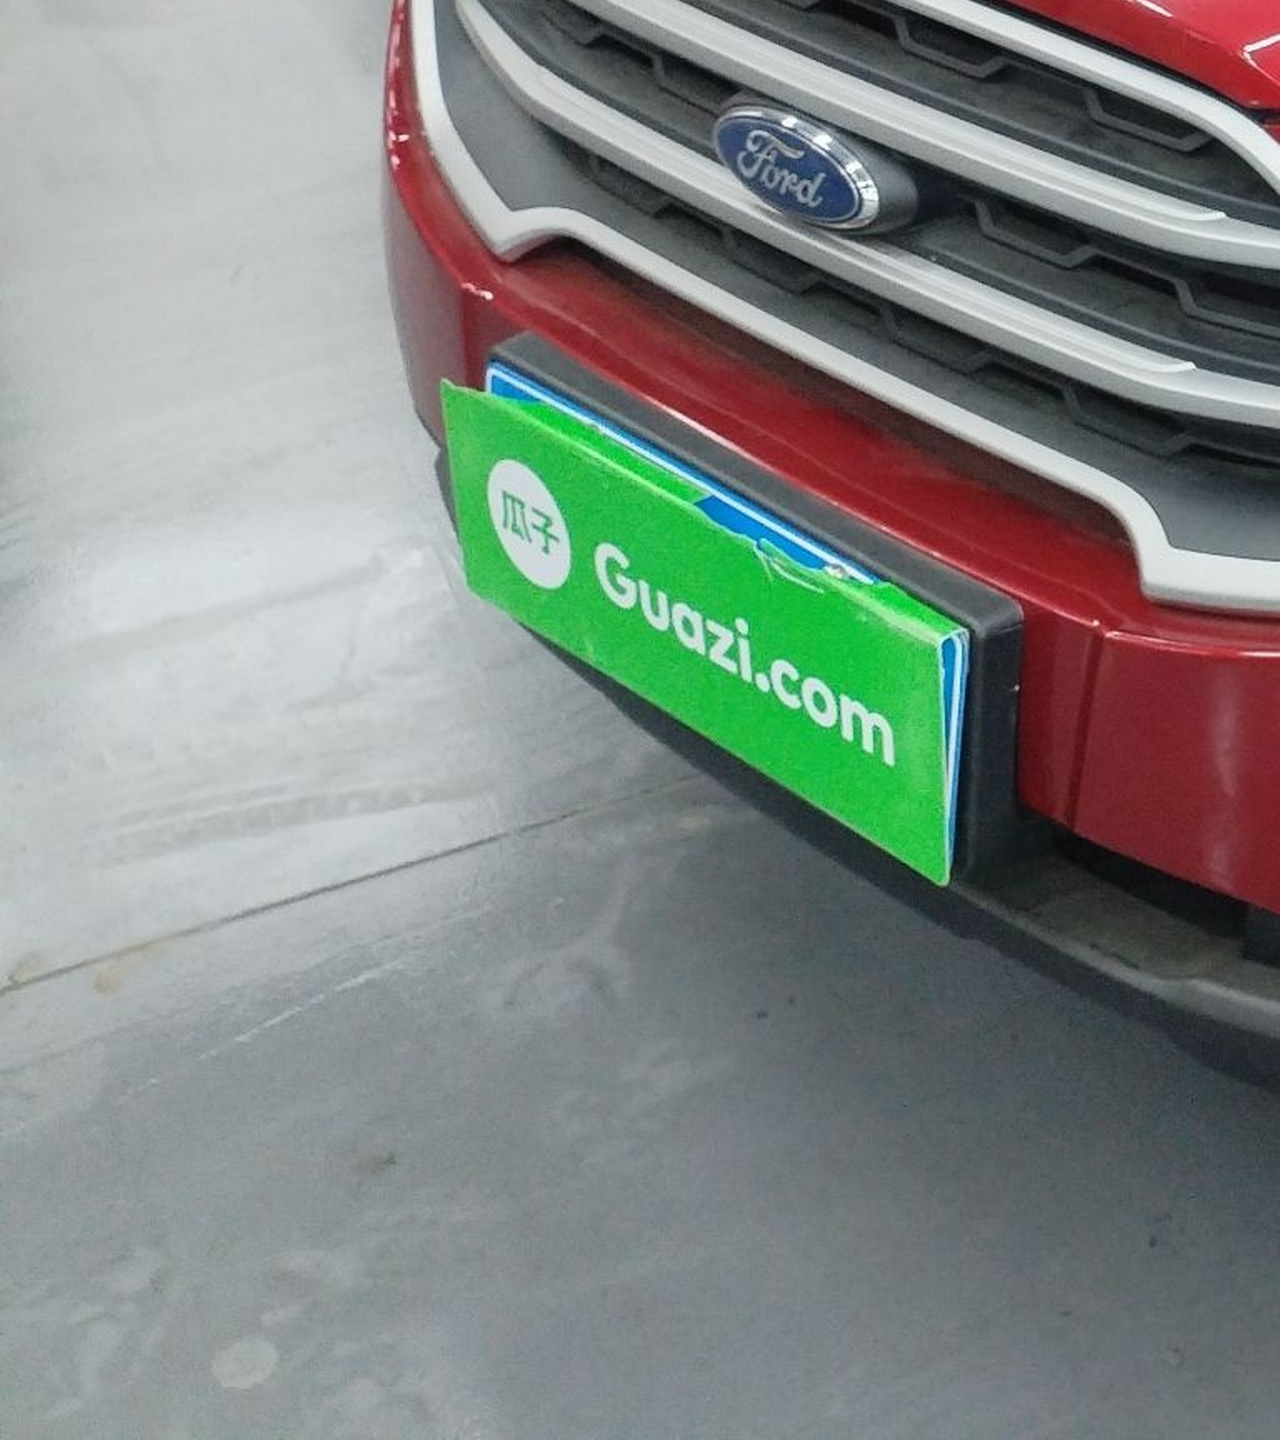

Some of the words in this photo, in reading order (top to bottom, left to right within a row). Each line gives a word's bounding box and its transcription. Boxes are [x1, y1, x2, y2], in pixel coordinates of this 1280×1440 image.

[737, 129, 827, 208] Ford
[501, 490, 560, 555] 瓜子
[594, 542, 896, 768] Guazi.com
